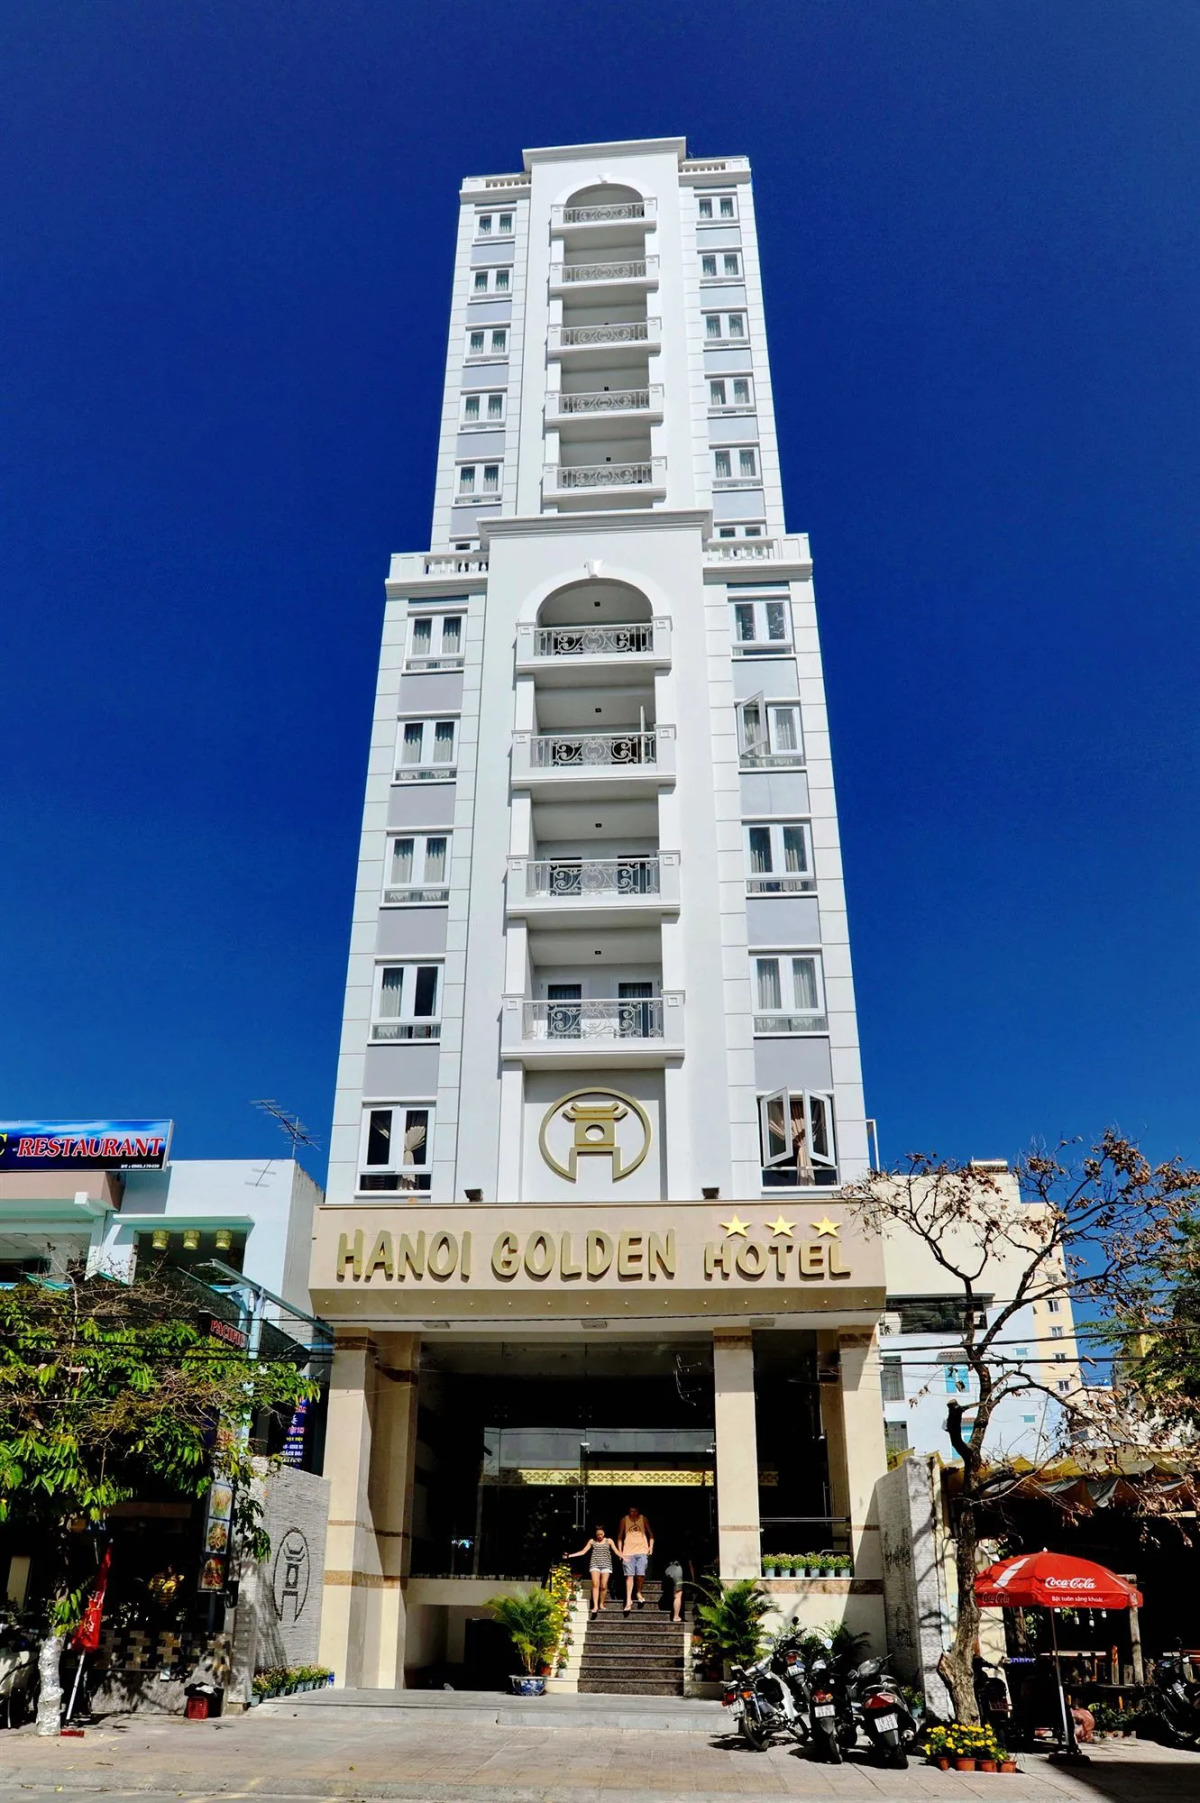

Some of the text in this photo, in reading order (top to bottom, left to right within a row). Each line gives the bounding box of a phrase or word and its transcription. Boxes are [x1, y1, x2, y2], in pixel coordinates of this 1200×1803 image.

[17, 1137, 164, 1158] RESTAURANT
[336, 1228, 853, 1282] HANOI GOLDEN HOTEL
[210, 1319, 247, 1348] PACIFIC
[1044, 1576, 1096, 1589] Coca-Cola
